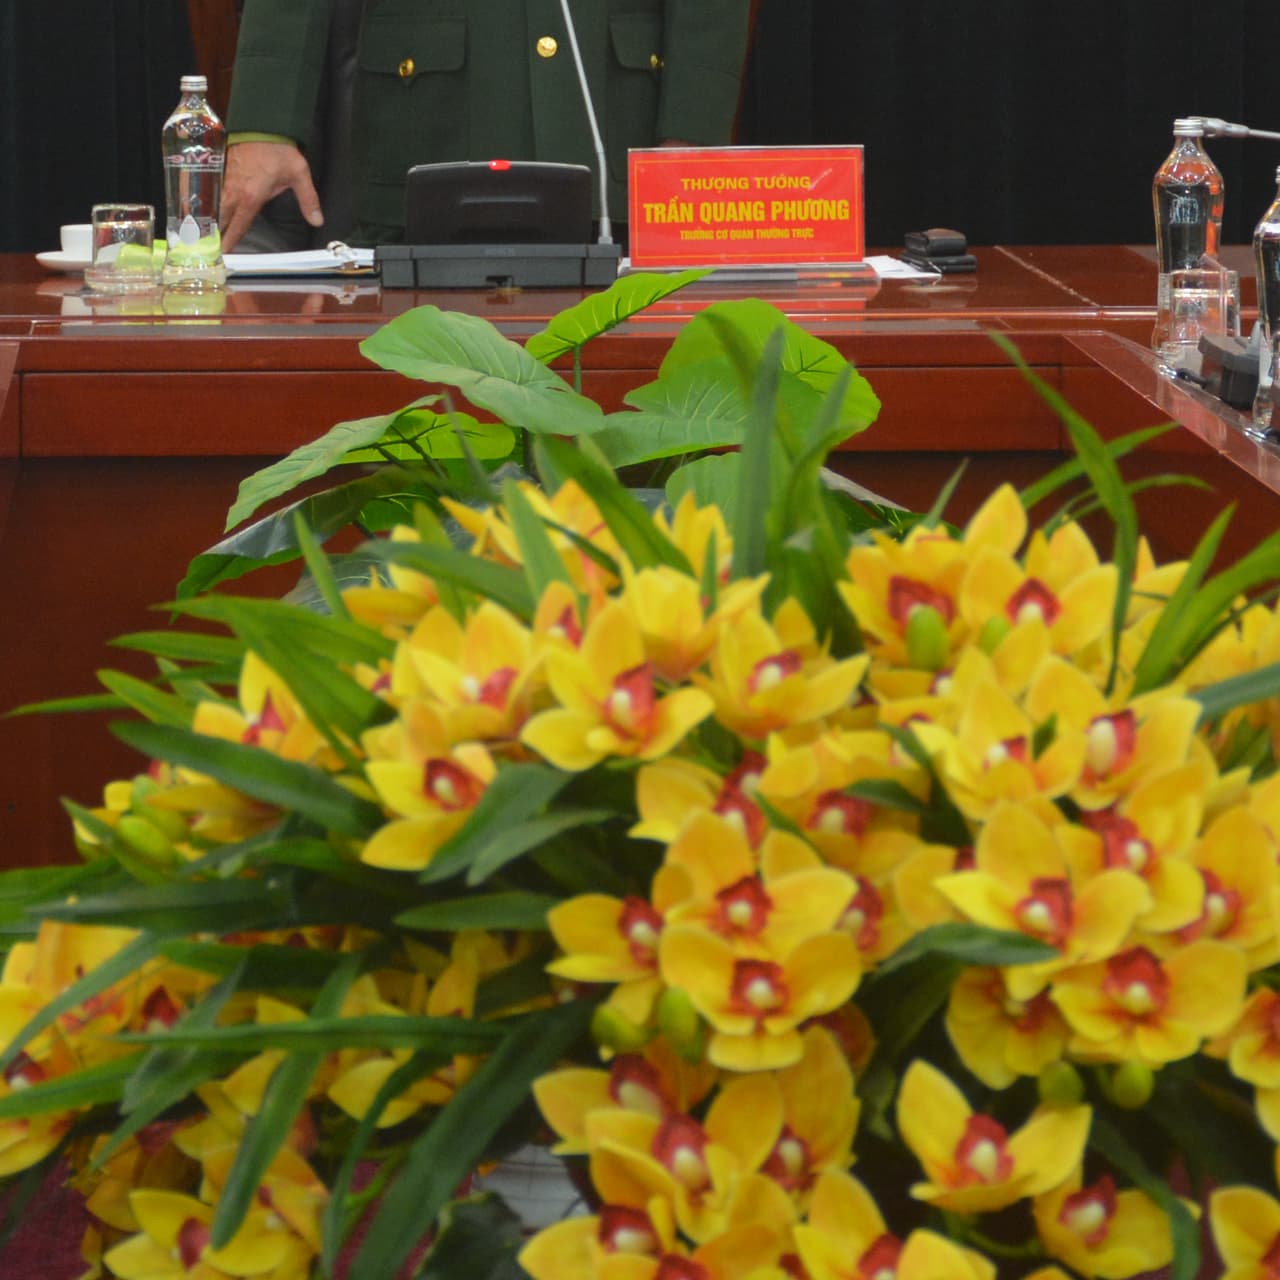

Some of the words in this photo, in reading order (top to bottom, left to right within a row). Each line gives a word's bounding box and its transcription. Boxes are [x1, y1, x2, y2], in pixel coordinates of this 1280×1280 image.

[680, 177, 750, 194] THƯỢNG
[754, 174, 811, 189] TƯỚNG
[643, 195, 694, 223] TRẦN
[700, 201, 766, 225] QUANG
[771, 197, 850, 221] PHƯƠNG
